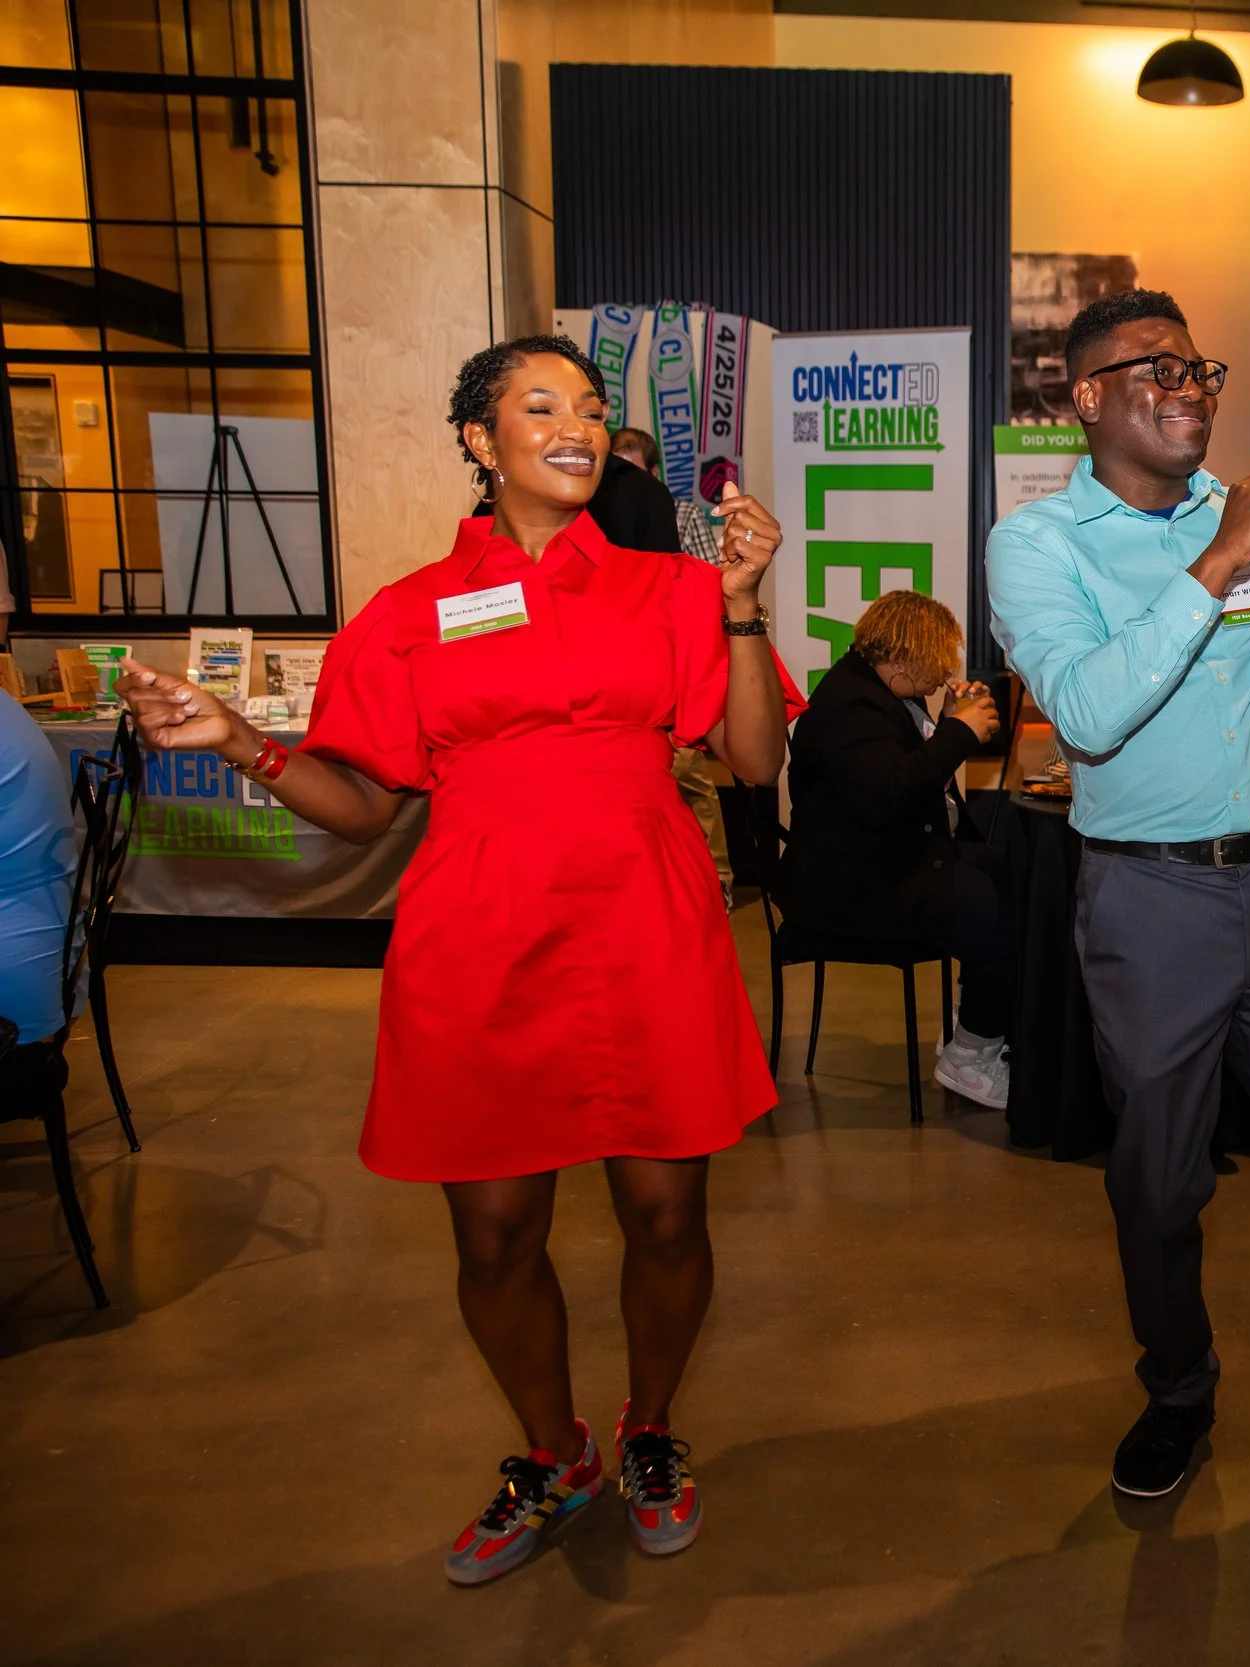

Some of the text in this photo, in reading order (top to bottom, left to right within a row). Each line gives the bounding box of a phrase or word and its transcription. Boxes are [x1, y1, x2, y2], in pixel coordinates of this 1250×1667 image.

[658, 338, 684, 374] CL
[712, 325, 737, 437] 4/25/26
[792, 357, 940, 408] CONNECTED
[657, 387, 694, 502] LEARNIN
[823, 401, 942, 451] LEARNING
[1021, 434, 1045, 447] DID
[1047, 434, 1075, 447] YOU
